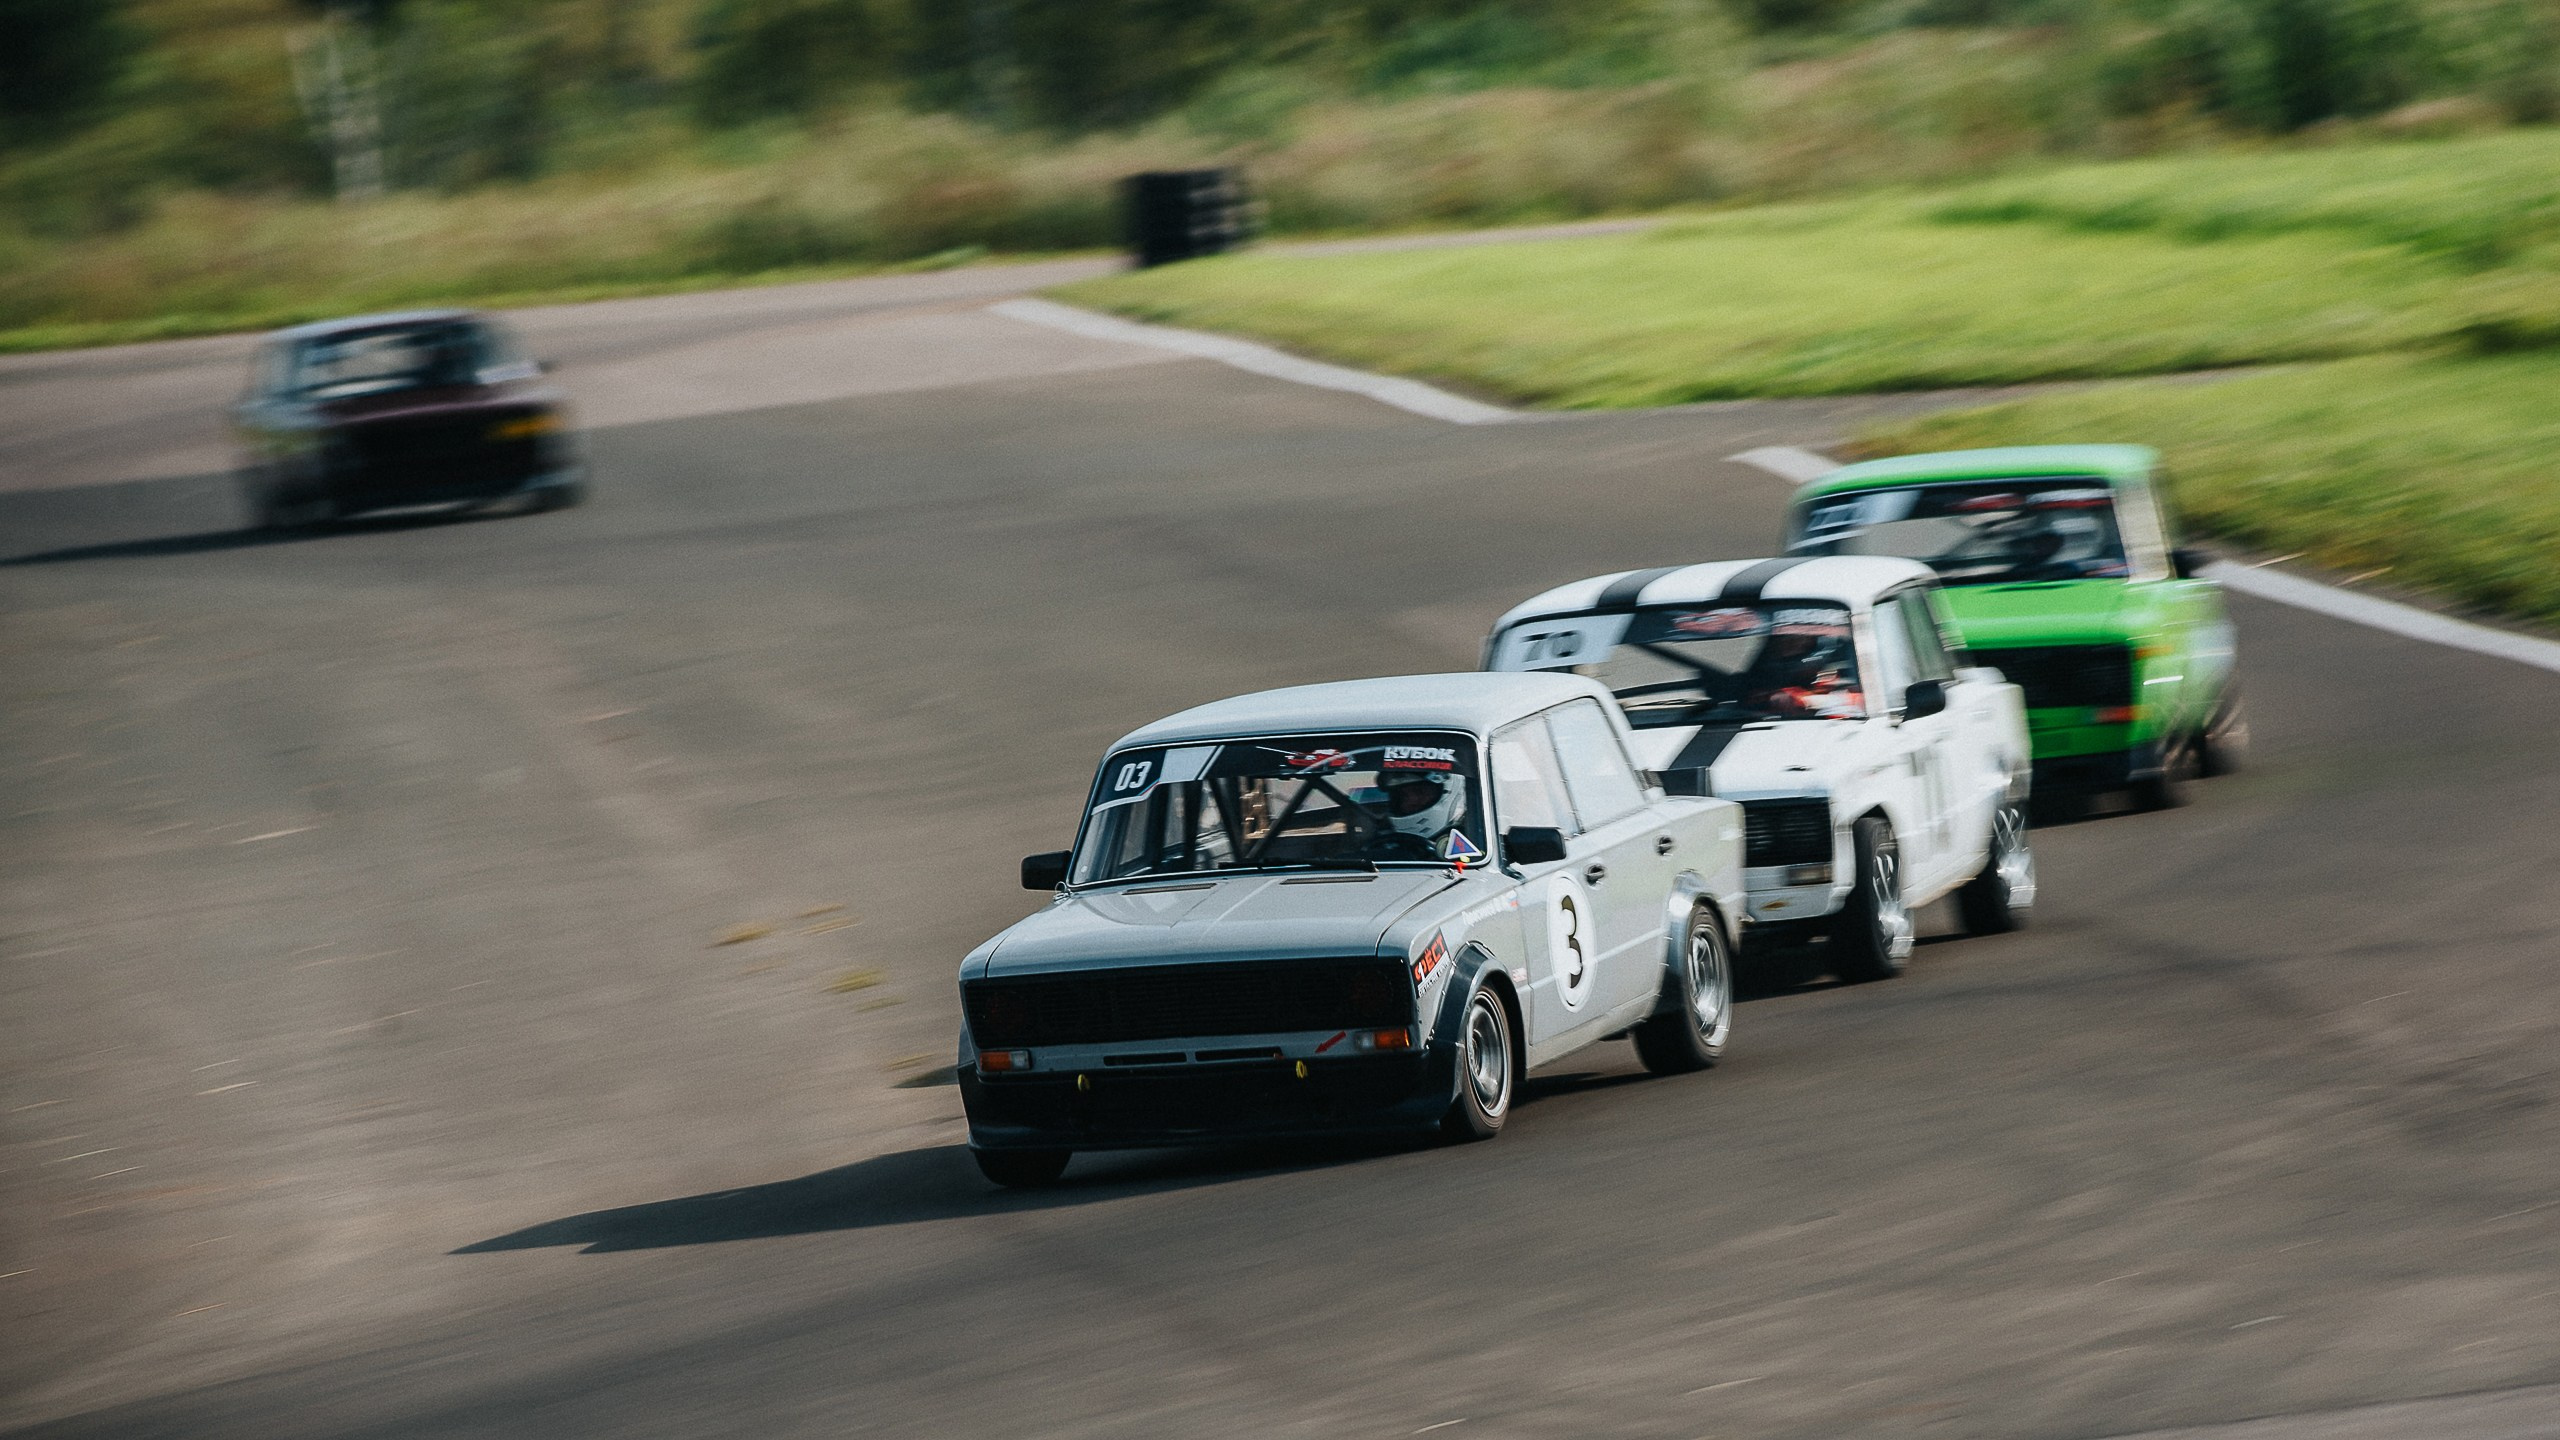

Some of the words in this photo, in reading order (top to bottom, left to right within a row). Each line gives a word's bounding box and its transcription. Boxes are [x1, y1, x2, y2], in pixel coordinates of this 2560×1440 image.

[1520, 629, 1584, 662] 70
[1383, 746, 1456, 762] КУБОК
[1114, 761, 1152, 791] 03
[1561, 895, 1583, 989] 3
